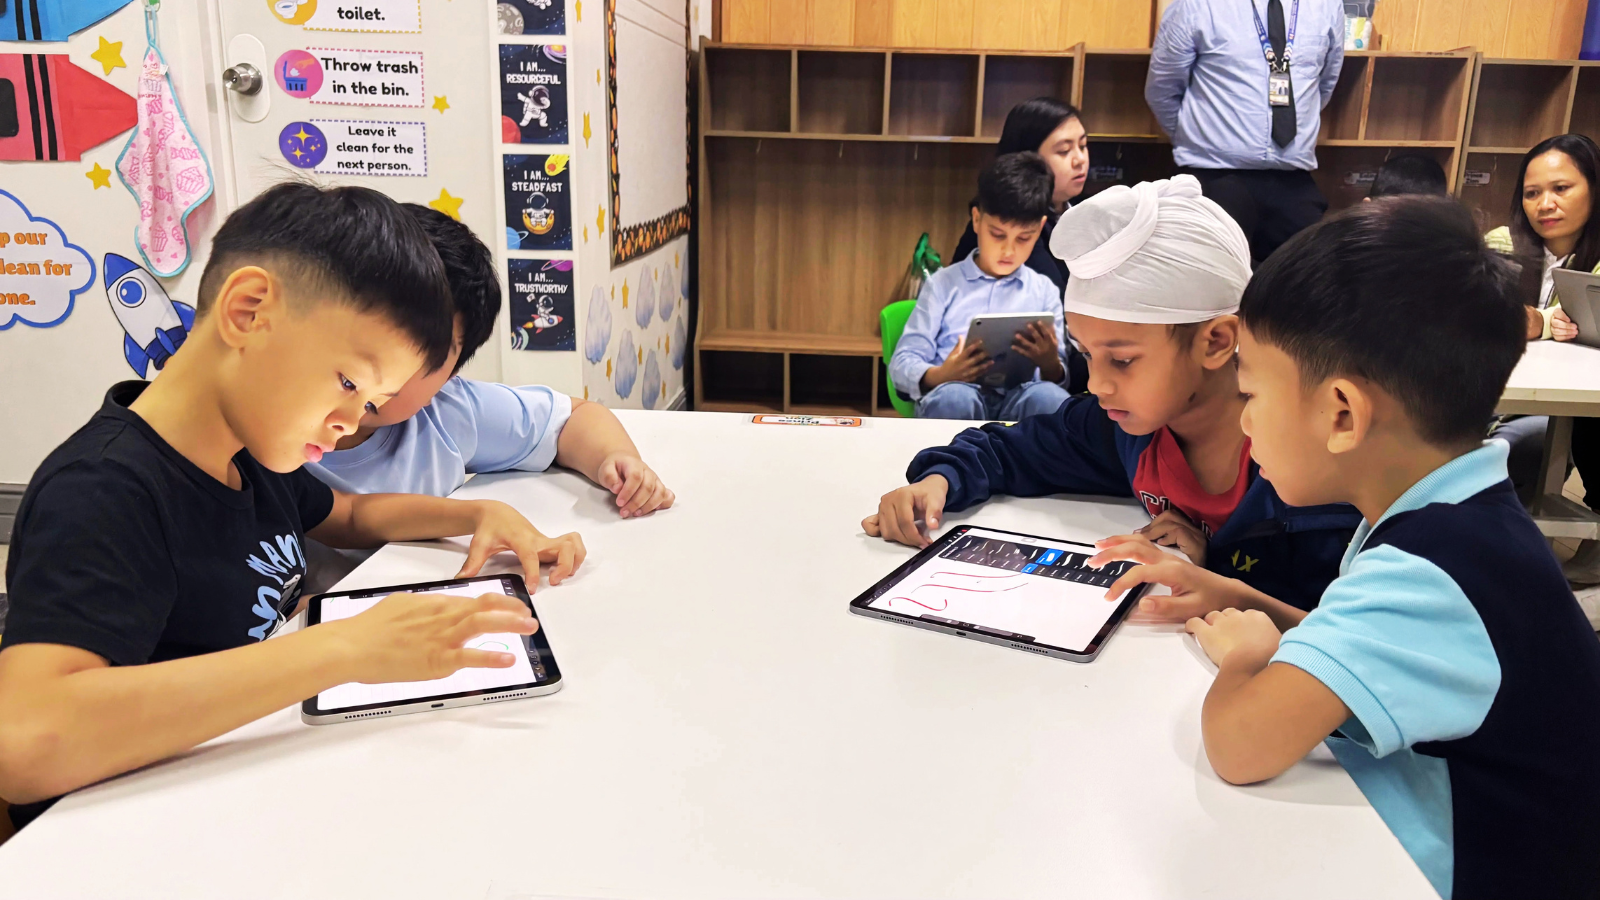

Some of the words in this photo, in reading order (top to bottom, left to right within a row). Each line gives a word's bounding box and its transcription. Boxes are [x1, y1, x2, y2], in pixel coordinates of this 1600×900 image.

[337, 6, 385, 21] toilet.
[321, 57, 372, 72] Throw
[376, 60, 419, 74] trash
[520, 61, 524, 71] I
[526, 62, 546, 72] AM...
[332, 80, 347, 94] in
[351, 82, 377, 95] the
[381, 82, 410, 96] bin.
[348, 126, 385, 137] Leave
[387, 126, 397, 137] it
[336, 142, 369, 153] clean
[372, 143, 390, 154] for
[393, 143, 414, 154] the
[337, 160, 364, 170] next
[367, 161, 412, 172] person.
[523, 170, 527, 180] I
[530, 170, 549, 181] AM...
[511, 181, 563, 193] STEADFAST
[14, 232, 48, 246] our
[43, 259, 72, 276] for
[528, 272, 532, 282] I
[534, 273, 553, 283] AM...
[514, 282, 568, 294] TRUSTWORTHY
